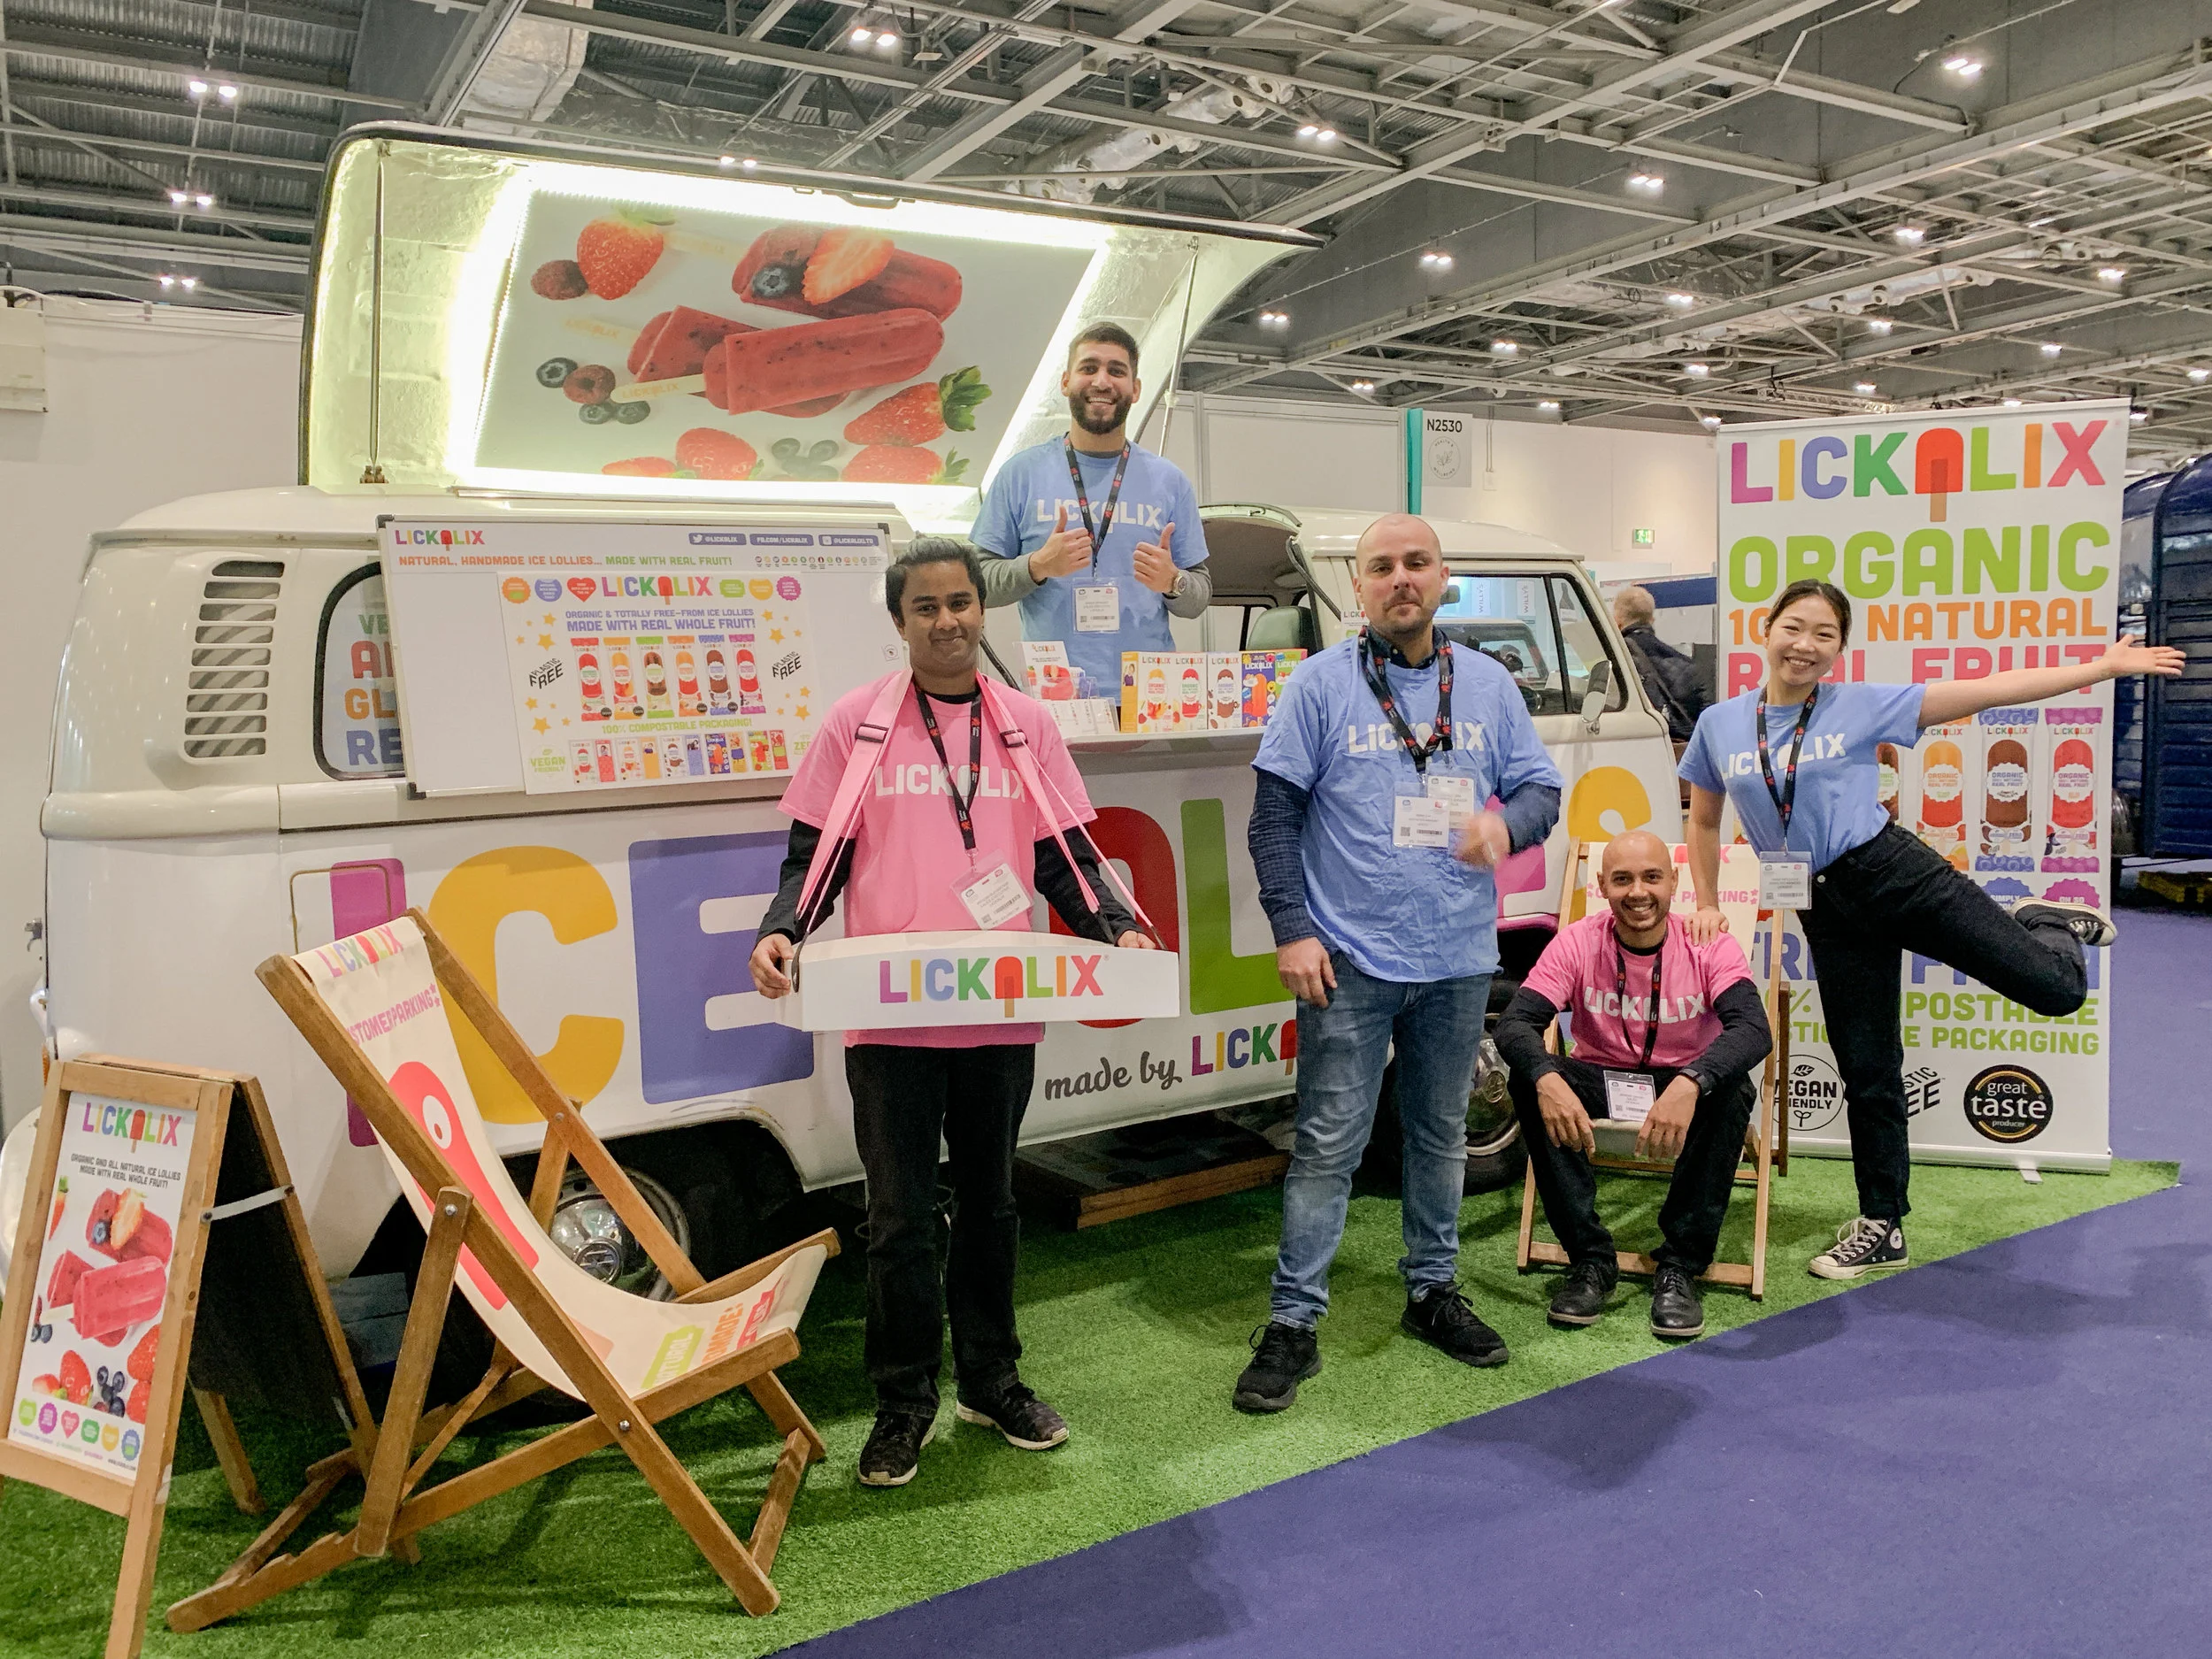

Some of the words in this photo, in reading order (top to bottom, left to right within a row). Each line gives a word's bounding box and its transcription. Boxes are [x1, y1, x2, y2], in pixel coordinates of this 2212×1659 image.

[1426, 419, 1463, 434] N2530
[1732, 420, 2108, 522] LICKALIX
[395, 530, 485, 551] LICKALIX
[399, 556, 458, 566] NATURAL,
[461, 556, 526, 565] HANDMADE
[528, 556, 547, 565] ICE
[549, 556, 603, 565] LOLLIES...
[605, 556, 636, 565] MADE
[638, 556, 666, 565] WITH
[670, 556, 696, 565] REAL
[699, 556, 733, 565] FRUIT!
[1729, 521, 2110, 603] ORGANIC
[601, 576, 713, 605] LICKALIX
[567, 620, 603, 631] MADE
[605, 620, 638, 631] WITH
[641, 619, 672, 630] REAL
[675, 619, 716, 629] WHOLE
[718, 618, 756, 629] FRUIT!
[1867, 597, 2108, 642] NATURAL
[529, 663, 564, 689] FREE
[533, 657, 561, 678] PLASTIC
[772, 656, 802, 680] FREE
[629, 721, 696, 733] COMPOSTABLE
[699, 718, 752, 730] PACKAGING!
[1986, 727, 2029, 738] LICKALIX
[2054, 727, 2094, 738] LICKALIX
[531, 757, 566, 767] VEGAN
[879, 955, 1104, 1018] LICKALIX
[1584, 986, 1706, 1021] LICKALIX
[1932, 1026, 2100, 1056] PACKAGING
[1045, 1056, 1132, 1101] made
[1140, 1051, 1182, 1090] by
[1986, 1082, 2028, 1097] great
[1970, 1095, 2047, 1119] taste
[82, 1102, 181, 1154] LICKALIX
[71, 1154, 95, 1164] ORGANIC
[96, 1158, 107, 1167] AND
[108, 1160, 119, 1169] ALL
[120, 1163, 145, 1175] NATURAL
[147, 1166, 157, 1176] ICE
[157, 1170, 180, 1180] LOLLIES
[80, 1165, 96, 1175] MADE
[96, 1169, 111, 1178] WITH
[112, 1171, 127, 1181] REAL
[128, 1173, 148, 1185] WHOLE
[149, 1177, 168, 1188] FRUIT!
